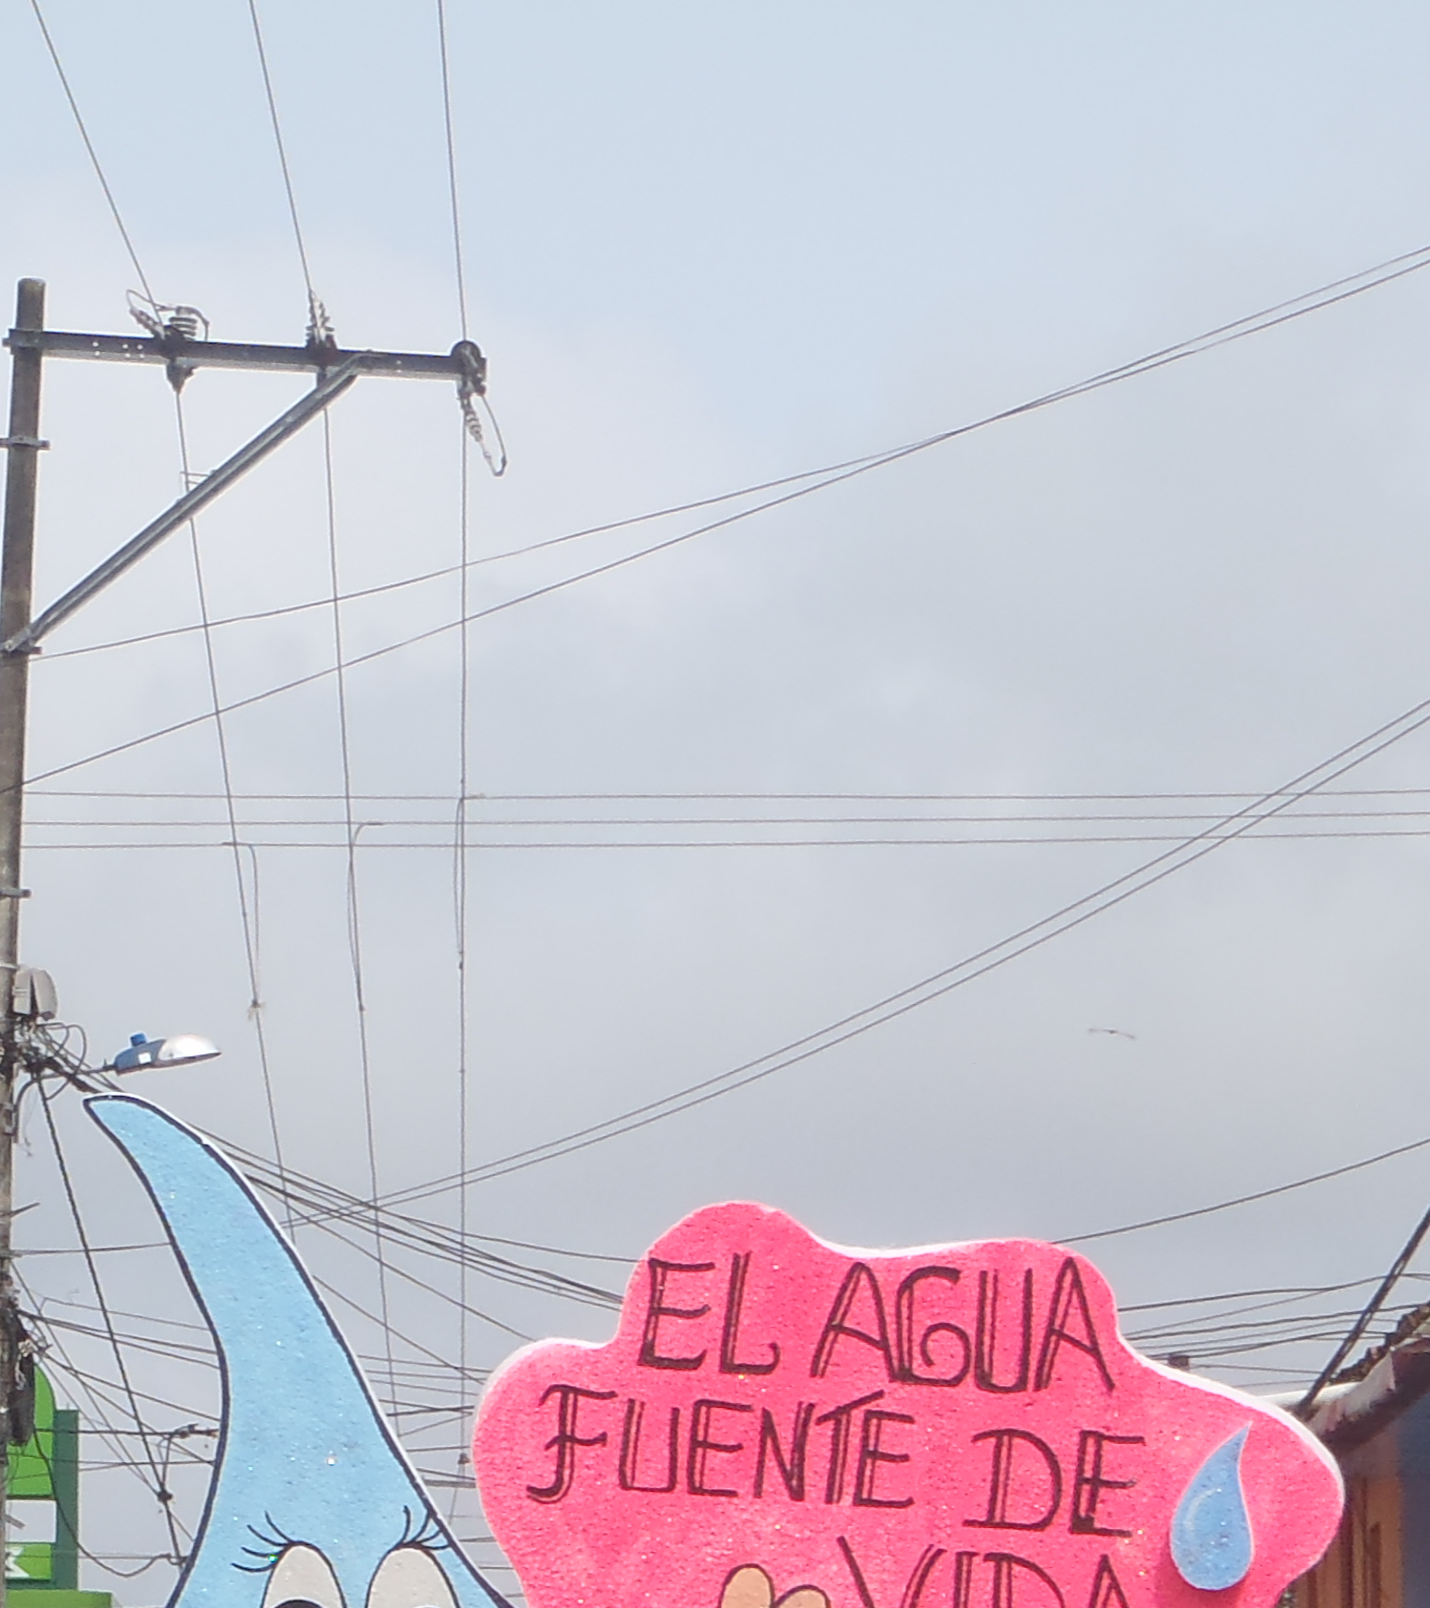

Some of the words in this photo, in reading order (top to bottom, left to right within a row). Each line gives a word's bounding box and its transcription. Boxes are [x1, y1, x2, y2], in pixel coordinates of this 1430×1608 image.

[639, 1252, 781, 1376] EL
[811, 1257, 1116, 1392] AGUA
[526, 1383, 915, 1510] FUENTE
[962, 1428, 1148, 1538] DE
